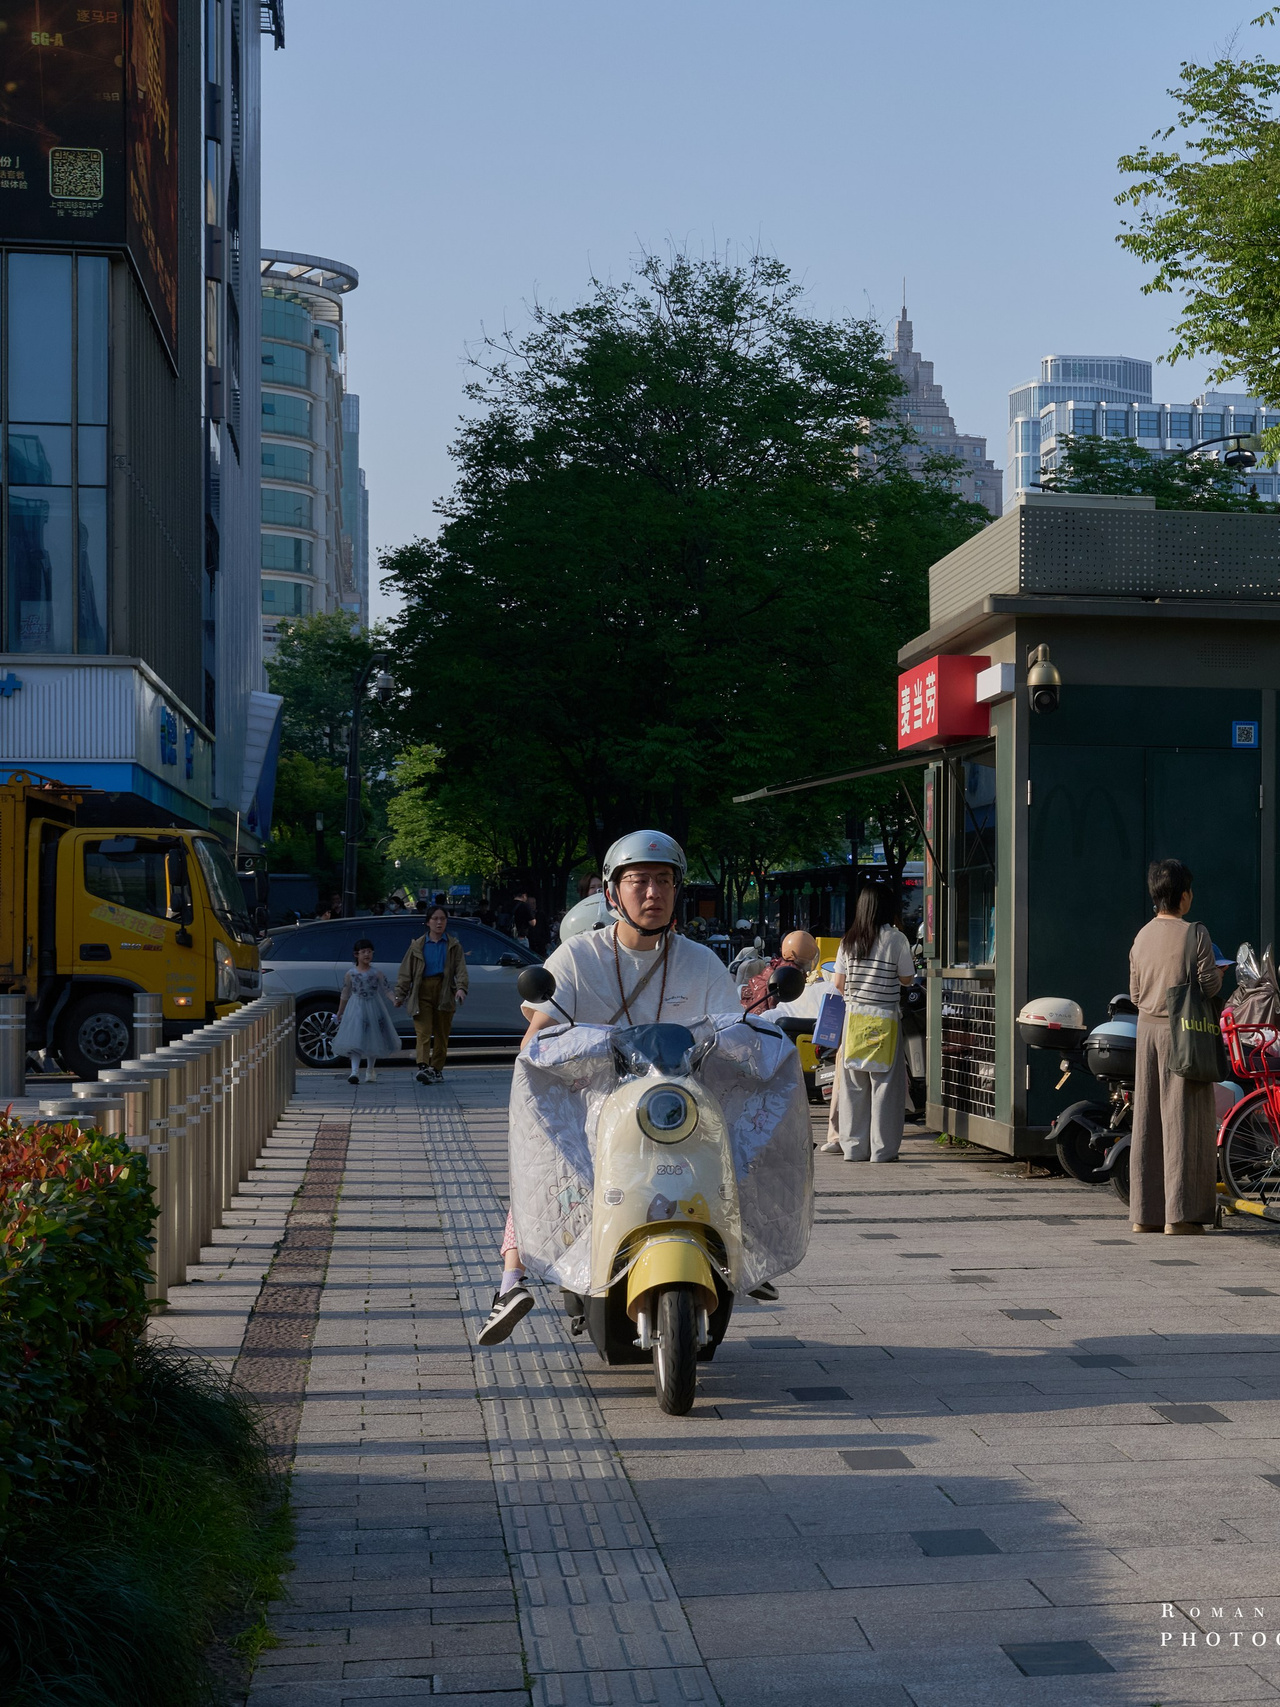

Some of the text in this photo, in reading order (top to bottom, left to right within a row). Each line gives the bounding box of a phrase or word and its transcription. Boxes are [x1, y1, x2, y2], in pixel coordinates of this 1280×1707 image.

[31, 31, 65, 47] 5G-A
[901, 671, 936, 737] 麦当劳
